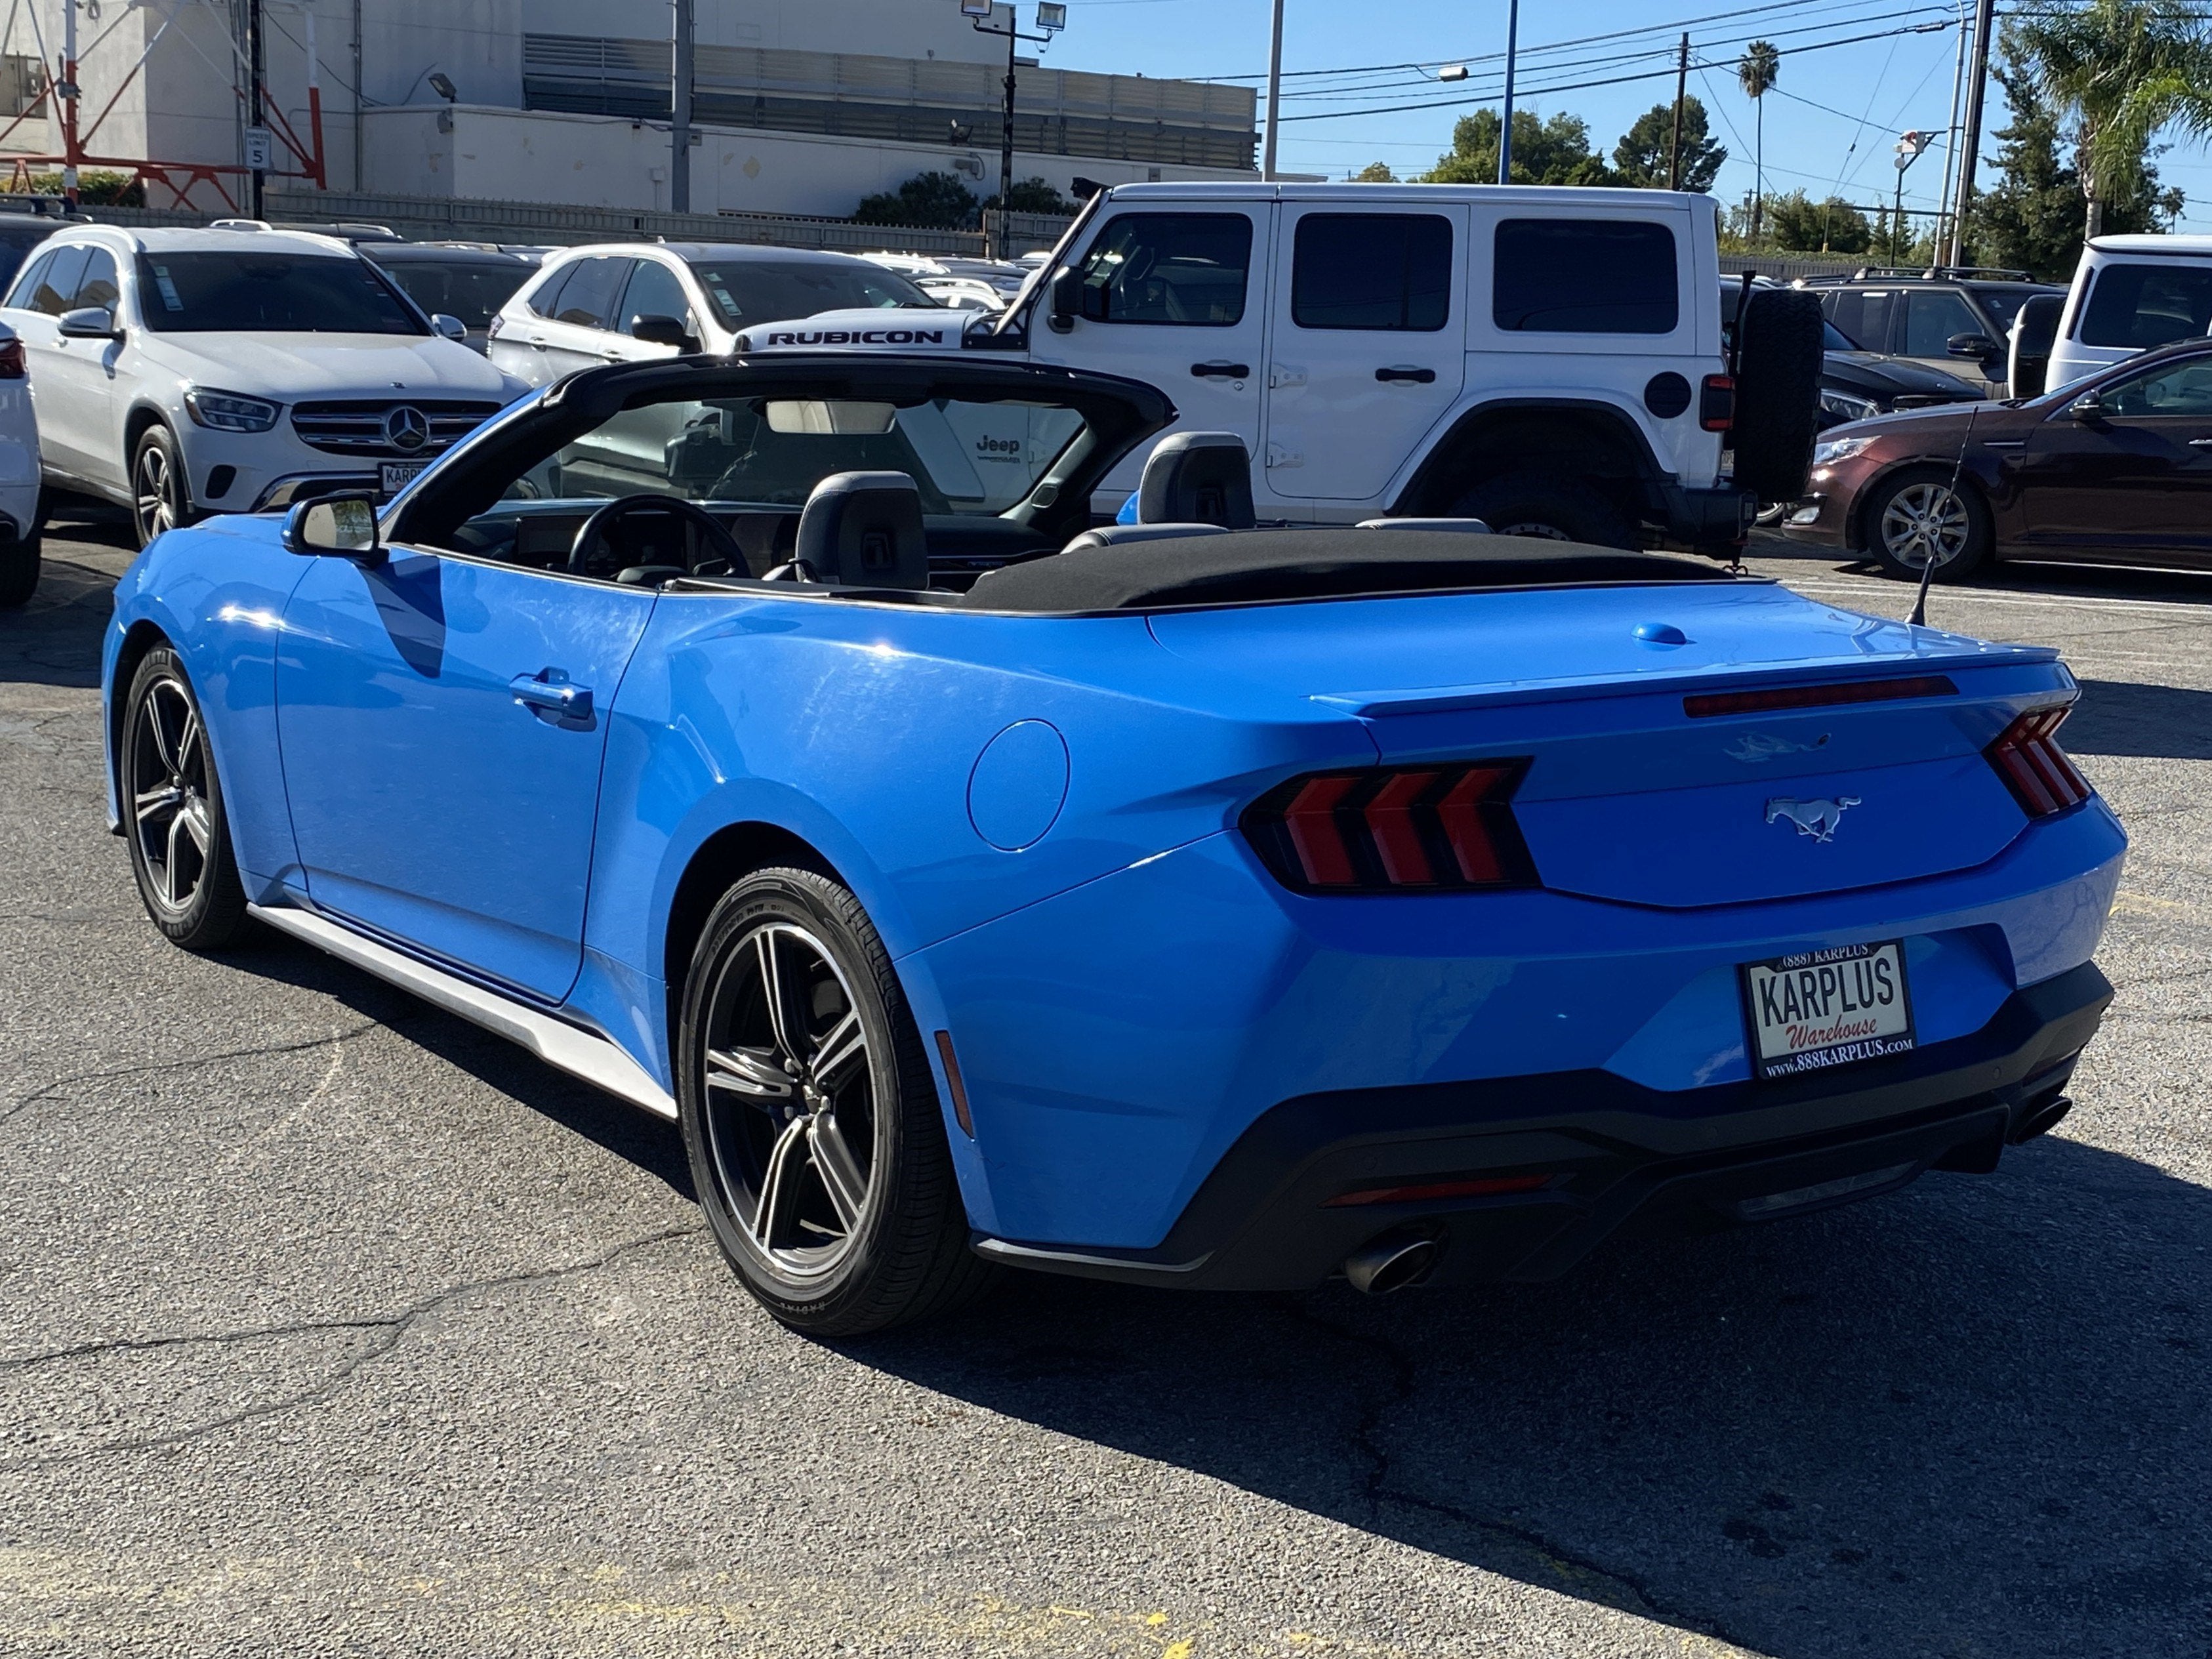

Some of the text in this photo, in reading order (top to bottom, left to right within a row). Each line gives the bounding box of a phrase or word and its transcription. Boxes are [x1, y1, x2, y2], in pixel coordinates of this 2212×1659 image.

[253, 150, 263, 163] 5
[768, 331, 943, 345] RUBICON
[977, 435, 1019, 454] Jeep
[386, 468, 420, 483] KARP
[1782, 943, 1868, 968] (888) KARPLUS
[1759, 957, 1894, 1027] KARPLUS
[1786, 1014, 1877, 1050] Warehouse
[779, 1301, 825, 1315] RADIAL
